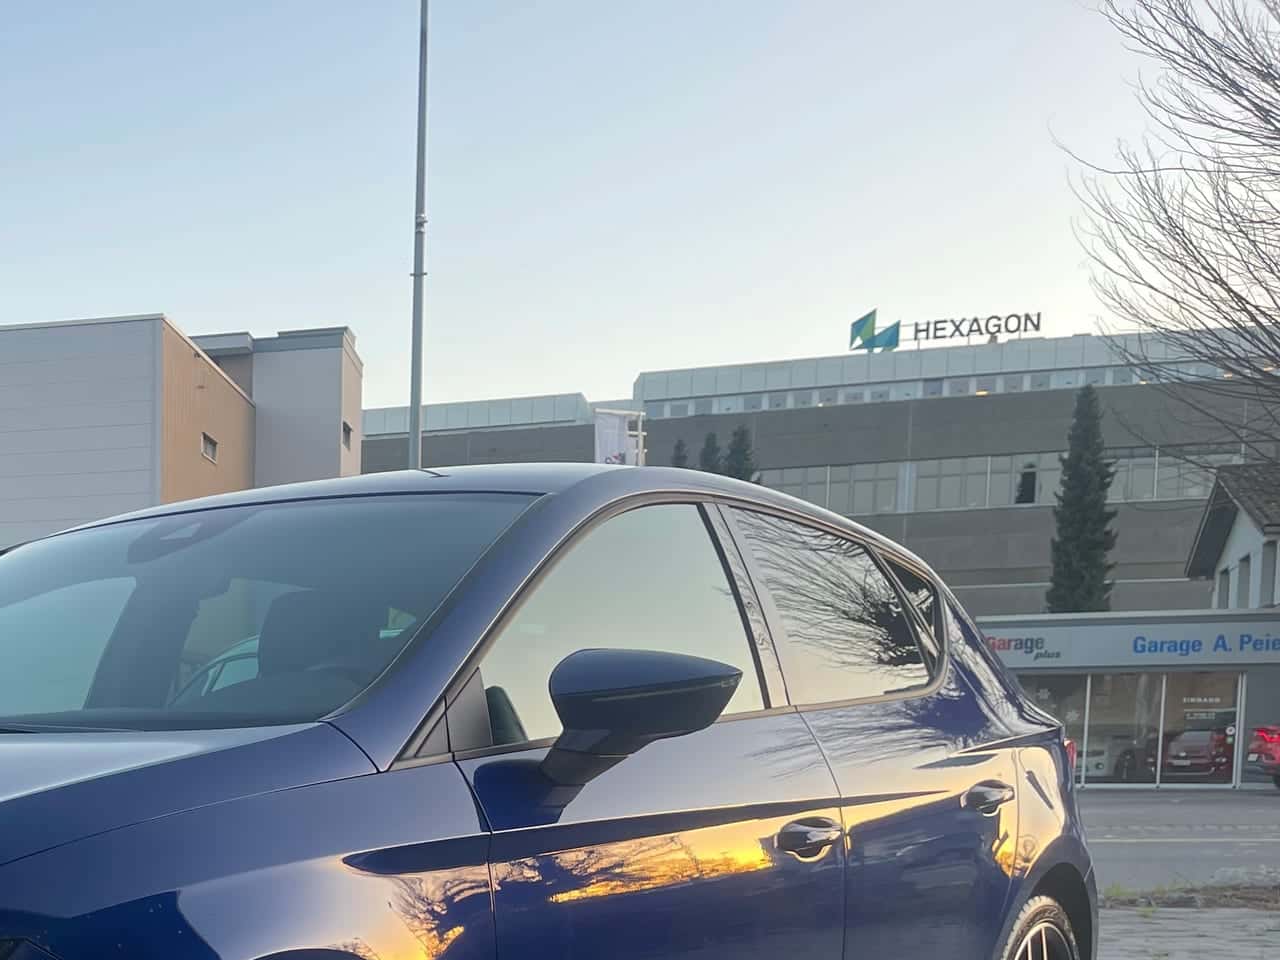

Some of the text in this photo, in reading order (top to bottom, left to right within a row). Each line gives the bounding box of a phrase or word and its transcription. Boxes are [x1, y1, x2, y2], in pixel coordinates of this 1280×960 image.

[913, 311, 1042, 341] HEXAGON
[1033, 650, 1062, 661] plus
[1132, 635, 1203, 656] Garage
[1213, 634, 1232, 652] A.
